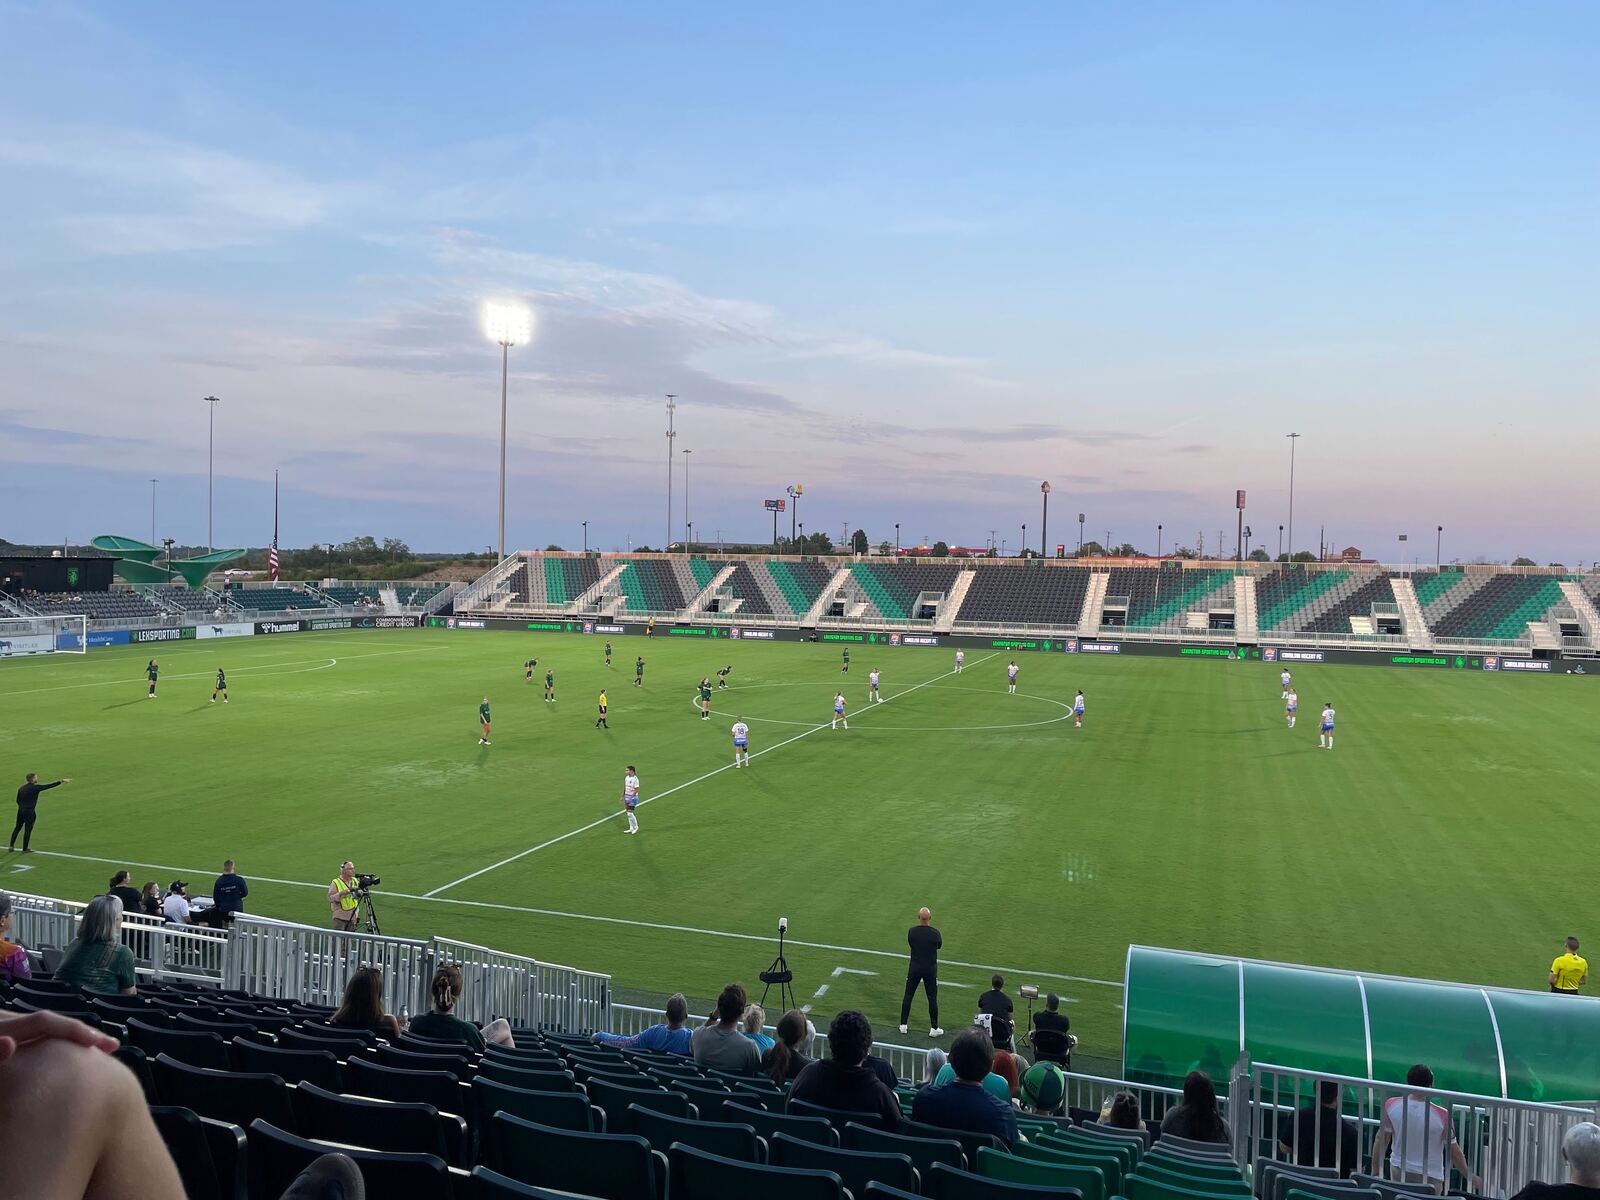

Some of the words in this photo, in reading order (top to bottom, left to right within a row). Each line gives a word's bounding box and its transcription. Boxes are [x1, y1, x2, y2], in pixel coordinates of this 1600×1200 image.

[271, 621, 299, 633] hummel
[138, 628, 196, 641] LEXSPORTING.COM
[737, 727, 745, 736] 18
